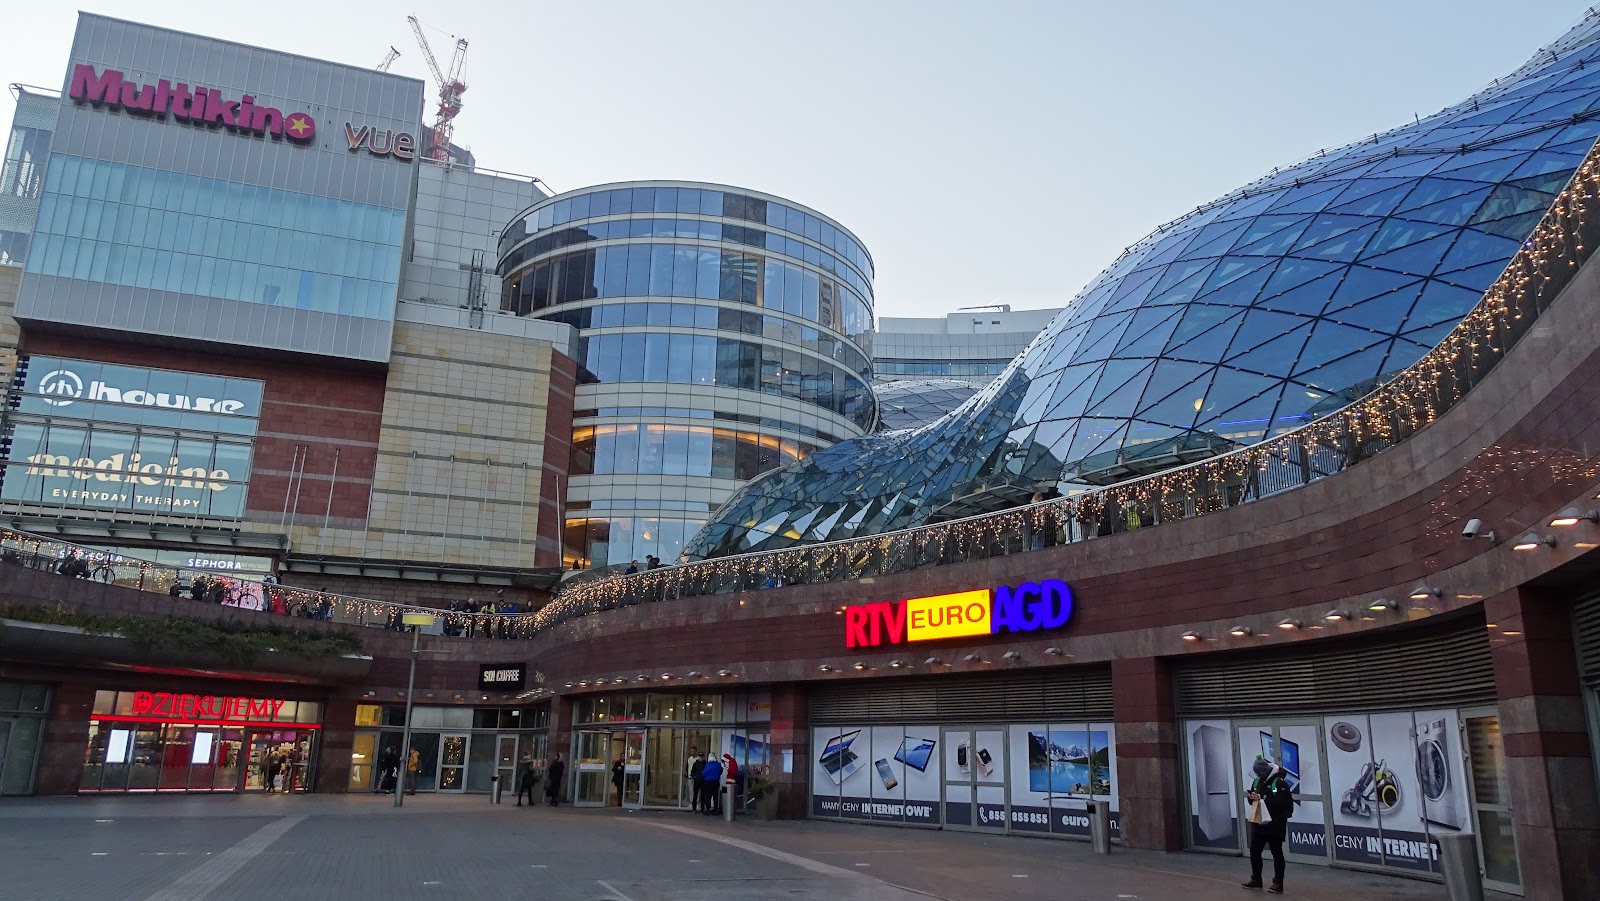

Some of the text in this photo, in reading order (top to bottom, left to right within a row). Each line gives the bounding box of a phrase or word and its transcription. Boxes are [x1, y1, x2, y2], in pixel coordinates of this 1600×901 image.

[68, 63, 316, 141] Multikino
[344, 121, 415, 159] vue
[88, 380, 245, 415] house
[25, 452, 230, 492] medicine
[52, 488, 201, 508] EVERYDAY THERAPY
[188, 558, 242, 570] SEPHORA
[845, 578, 1073, 649] RTV EURO AGD
[483, 668, 520, 682] SO! COFFEE
[821, 801, 840, 811] MAMY
[842, 802, 860, 812] CENY
[988, 810, 1048, 824] 855 855 855
[1291, 831, 1325, 846] MAMY
[1335, 834, 1364, 850] CENY
